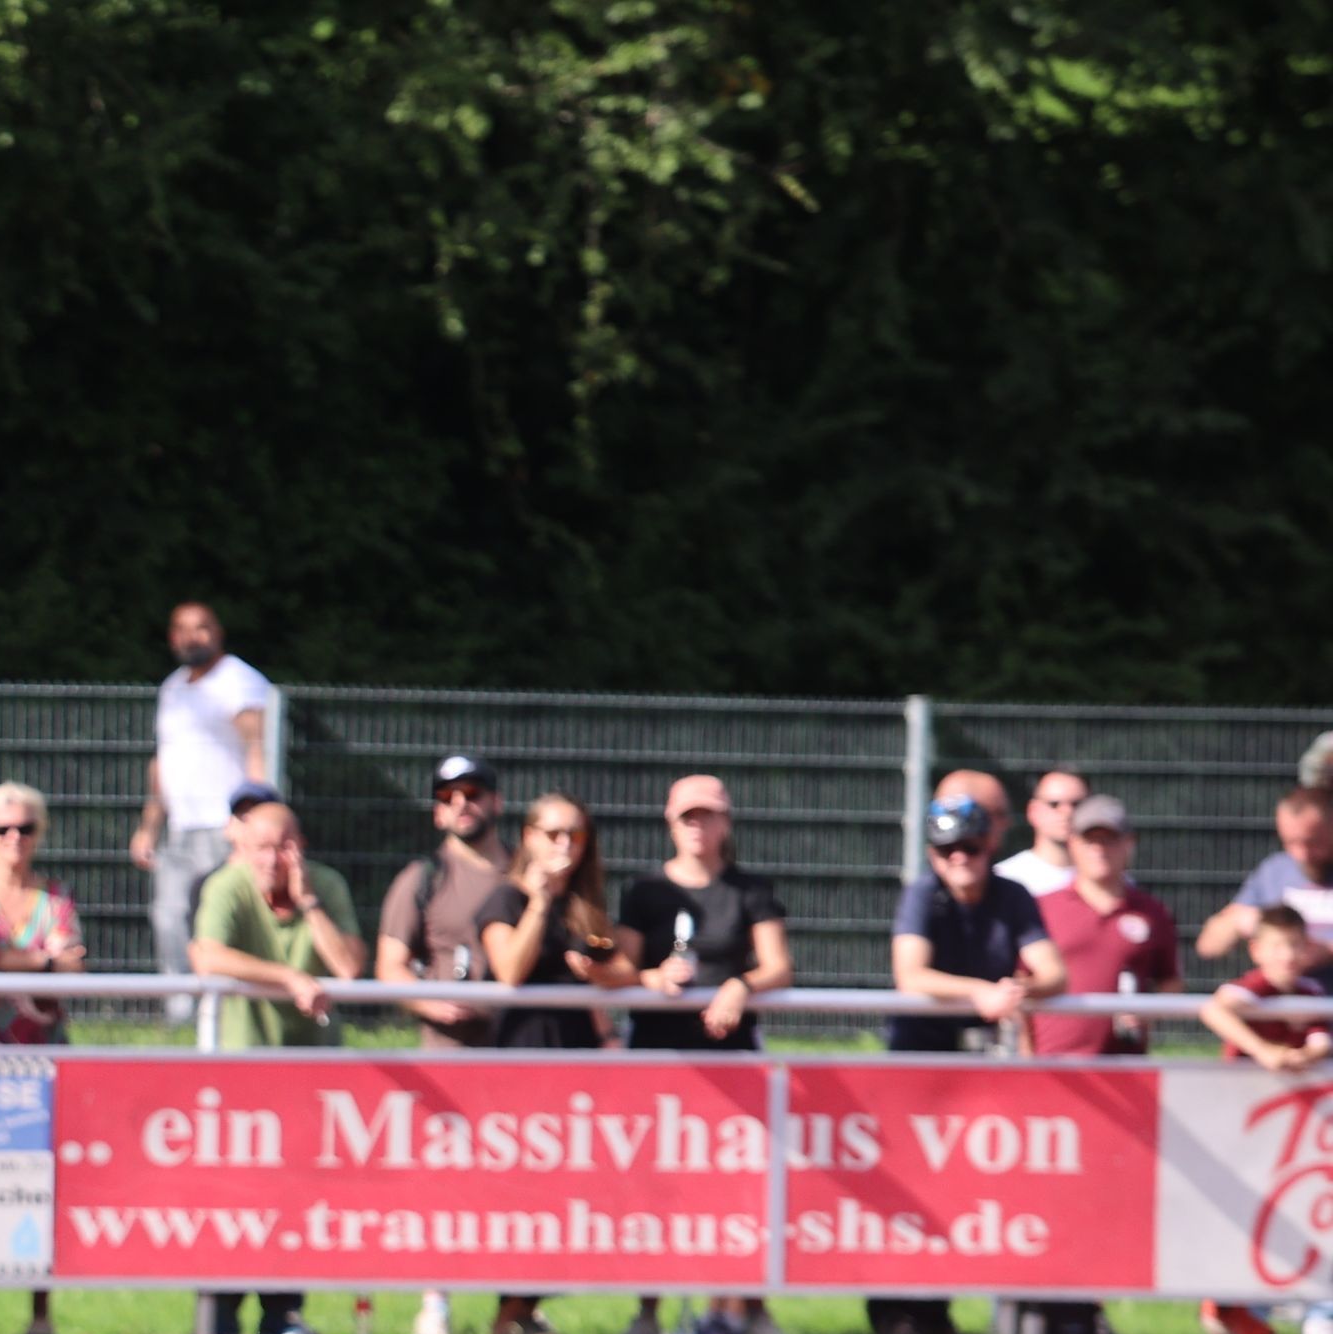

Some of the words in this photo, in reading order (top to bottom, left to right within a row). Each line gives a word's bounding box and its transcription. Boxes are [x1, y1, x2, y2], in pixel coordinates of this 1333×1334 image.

[143, 1088, 283, 1167] ein
[317, 1088, 882, 1174] Massivhaus
[911, 1114, 1084, 1174] von
